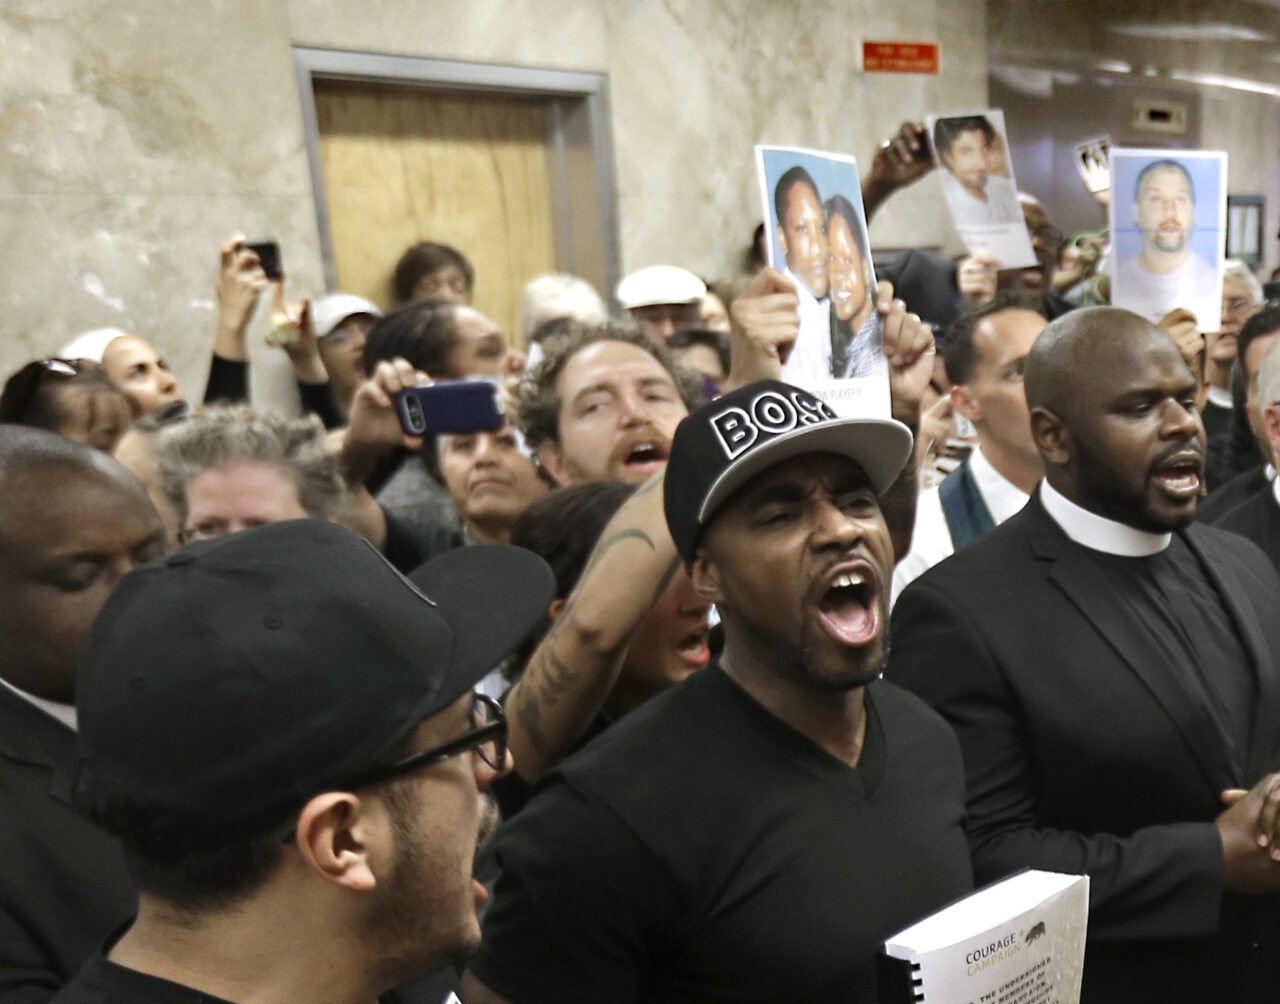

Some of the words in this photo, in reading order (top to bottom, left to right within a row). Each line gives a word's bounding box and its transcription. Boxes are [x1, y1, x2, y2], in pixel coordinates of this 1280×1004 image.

[966, 931, 1015, 966] COURAGE
[967, 942, 1020, 978] CAMPAIGN
[980, 989, 995, 1004] THE
[999, 956, 1051, 993] UNDERSIGNED
[999, 979, 1033, 1004] MEMBERS
